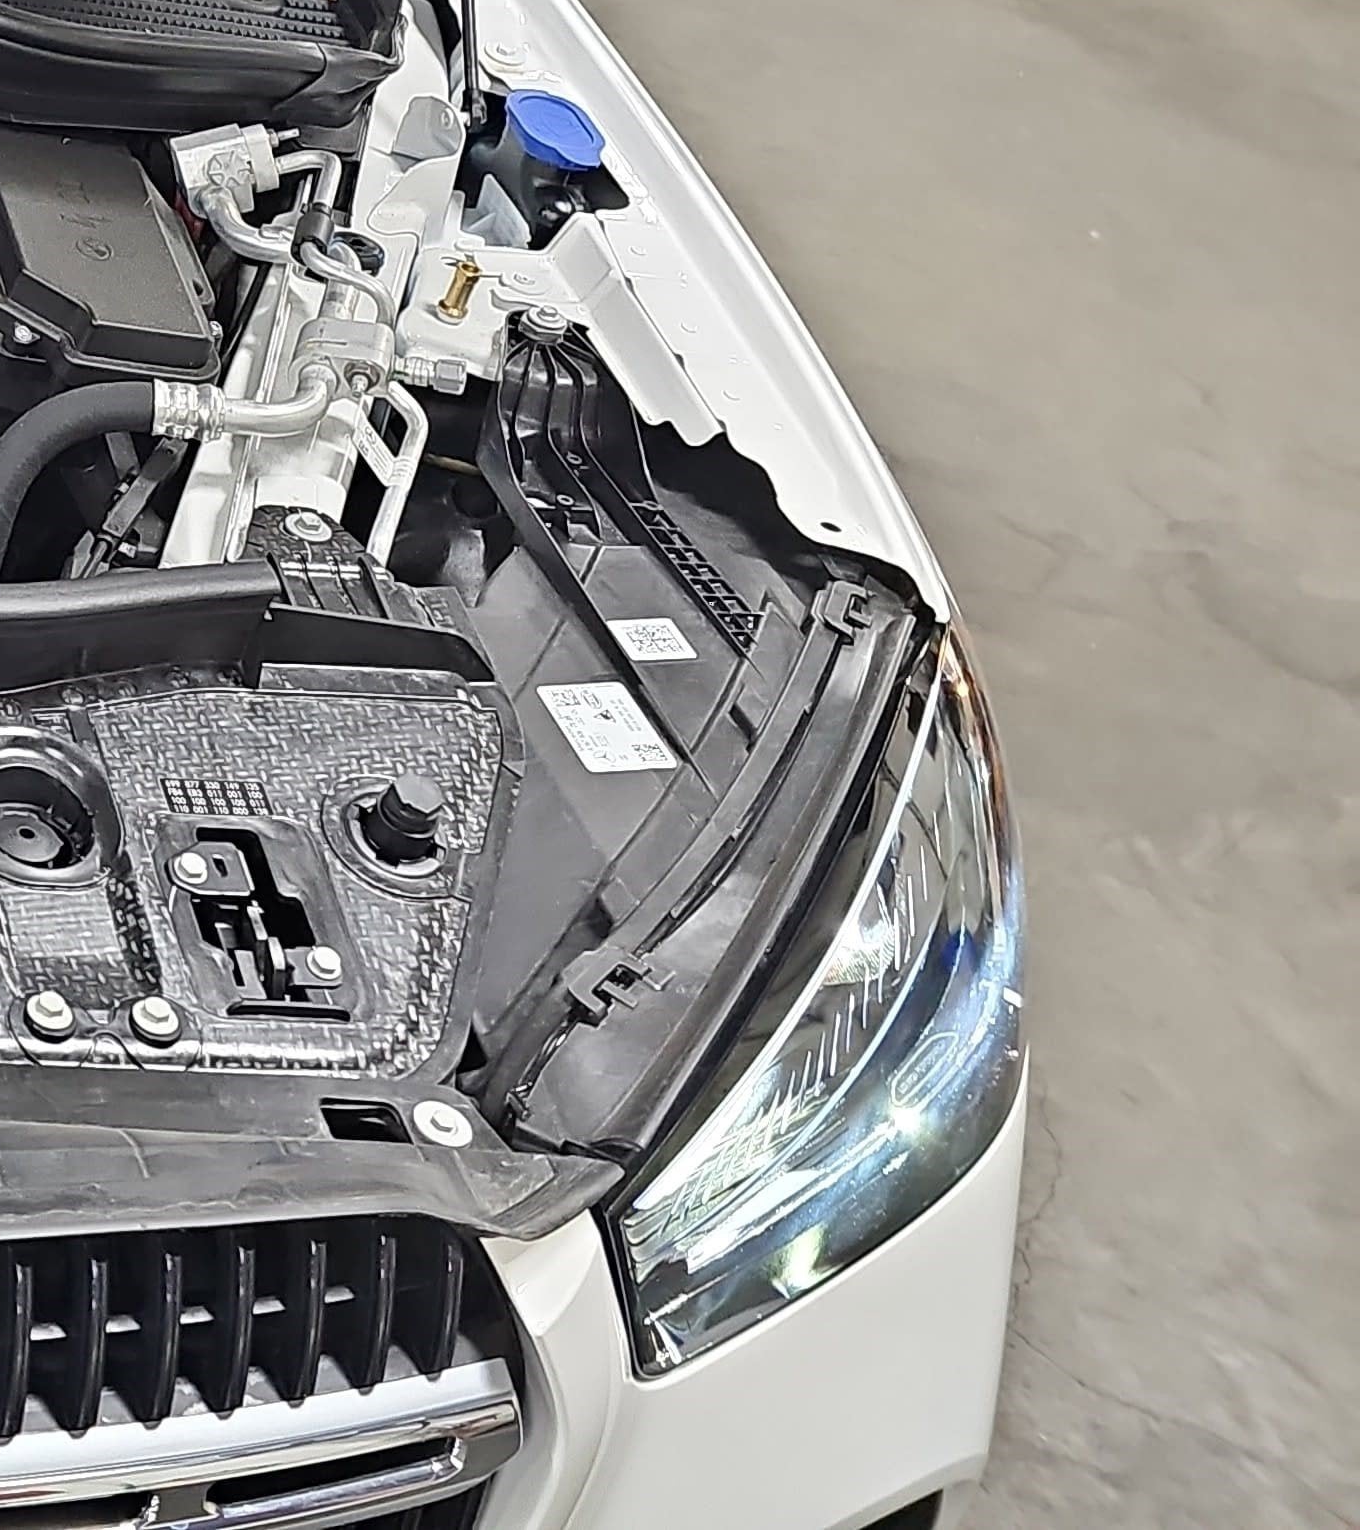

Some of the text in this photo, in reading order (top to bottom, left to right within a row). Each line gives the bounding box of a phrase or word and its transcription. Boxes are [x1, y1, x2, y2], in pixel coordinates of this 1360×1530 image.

[206, 790, 223, 798] 011
[227, 790, 242, 798] 001
[247, 791, 263, 799] 100
[171, 796, 265, 807] 100 100 100 100 011
[174, 805, 190, 813] 110
[193, 806, 209, 814] 001
[213, 806, 229, 814] 110
